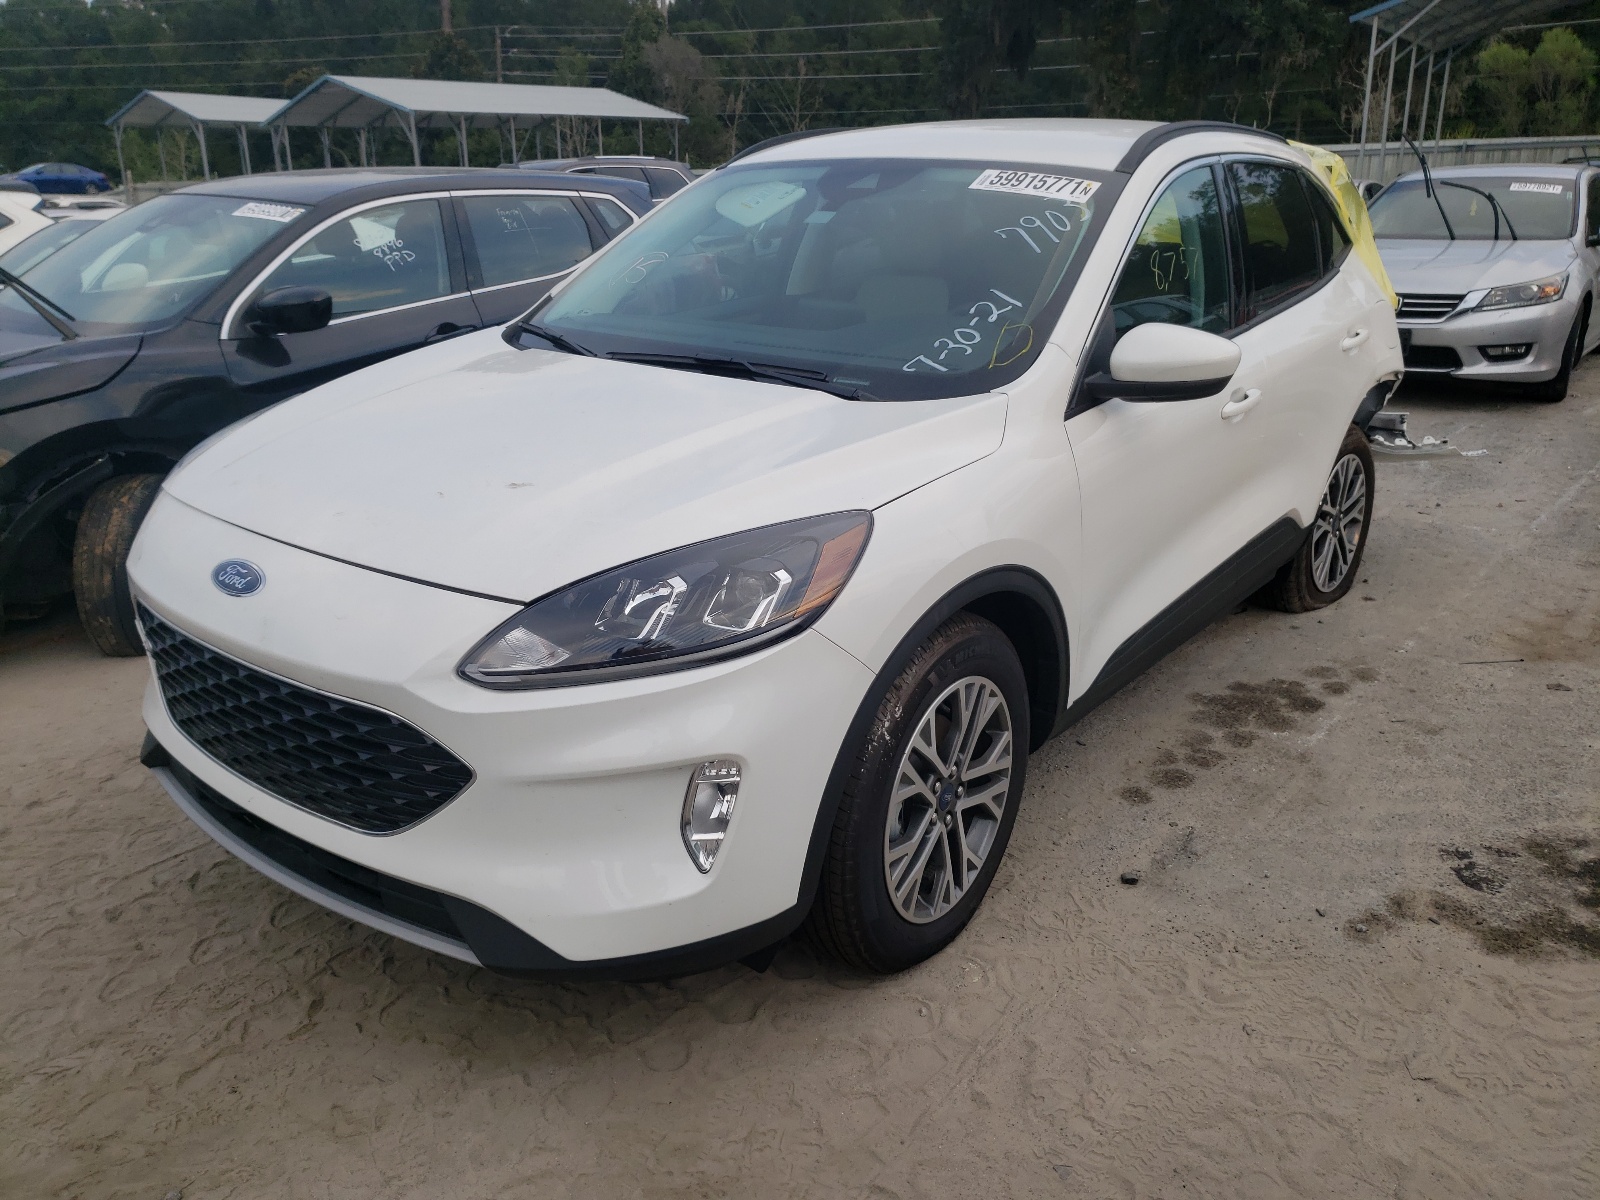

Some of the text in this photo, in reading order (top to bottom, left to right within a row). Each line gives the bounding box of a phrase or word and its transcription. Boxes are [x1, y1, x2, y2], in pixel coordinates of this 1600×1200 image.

[989, 171, 1084, 195] 59915771
[902, 288, 1023, 372] 7-30-21
[219, 564, 252, 589] Ford
